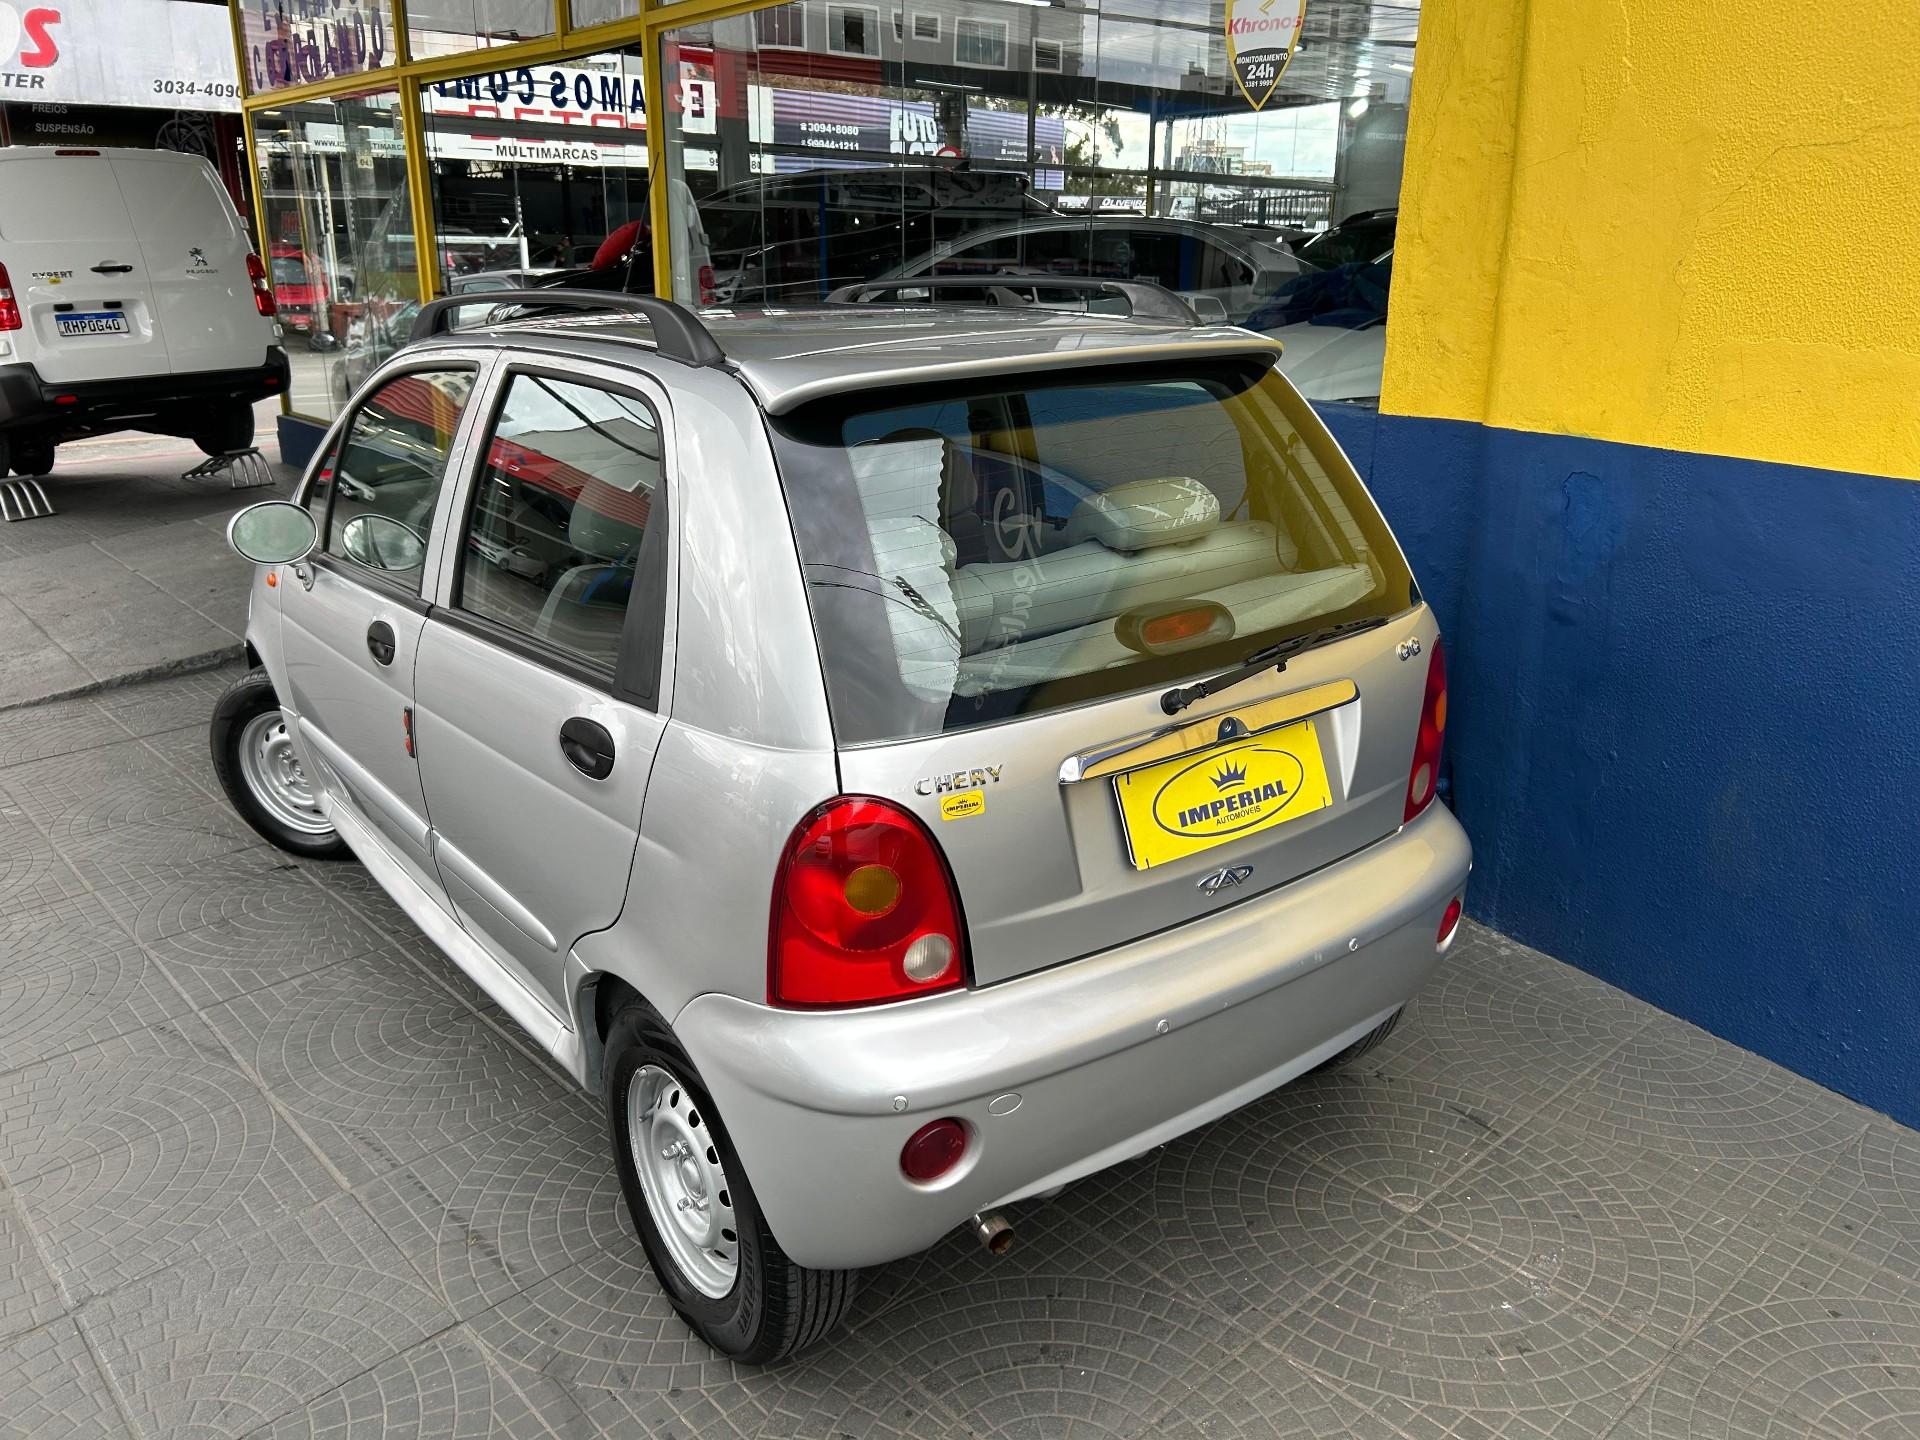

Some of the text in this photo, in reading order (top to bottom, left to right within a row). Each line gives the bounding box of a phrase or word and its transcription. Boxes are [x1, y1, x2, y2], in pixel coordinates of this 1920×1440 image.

[1228, 15, 1302, 35] Khronos
[1236, 53, 1288, 64] MONITORAMENTO
[1246, 63, 1275, 80] 24h
[32, 103, 68, 114] FREIOS
[35, 122, 95, 134] SUSPENSÃO
[496, 144, 598, 161] MULTIMARCAS
[32, 270, 74, 280] EXPERT
[914, 764, 1003, 796] CHERY
[945, 801, 979, 812] IMPERIAL
[1178, 780, 1288, 828] IMPERIAL
